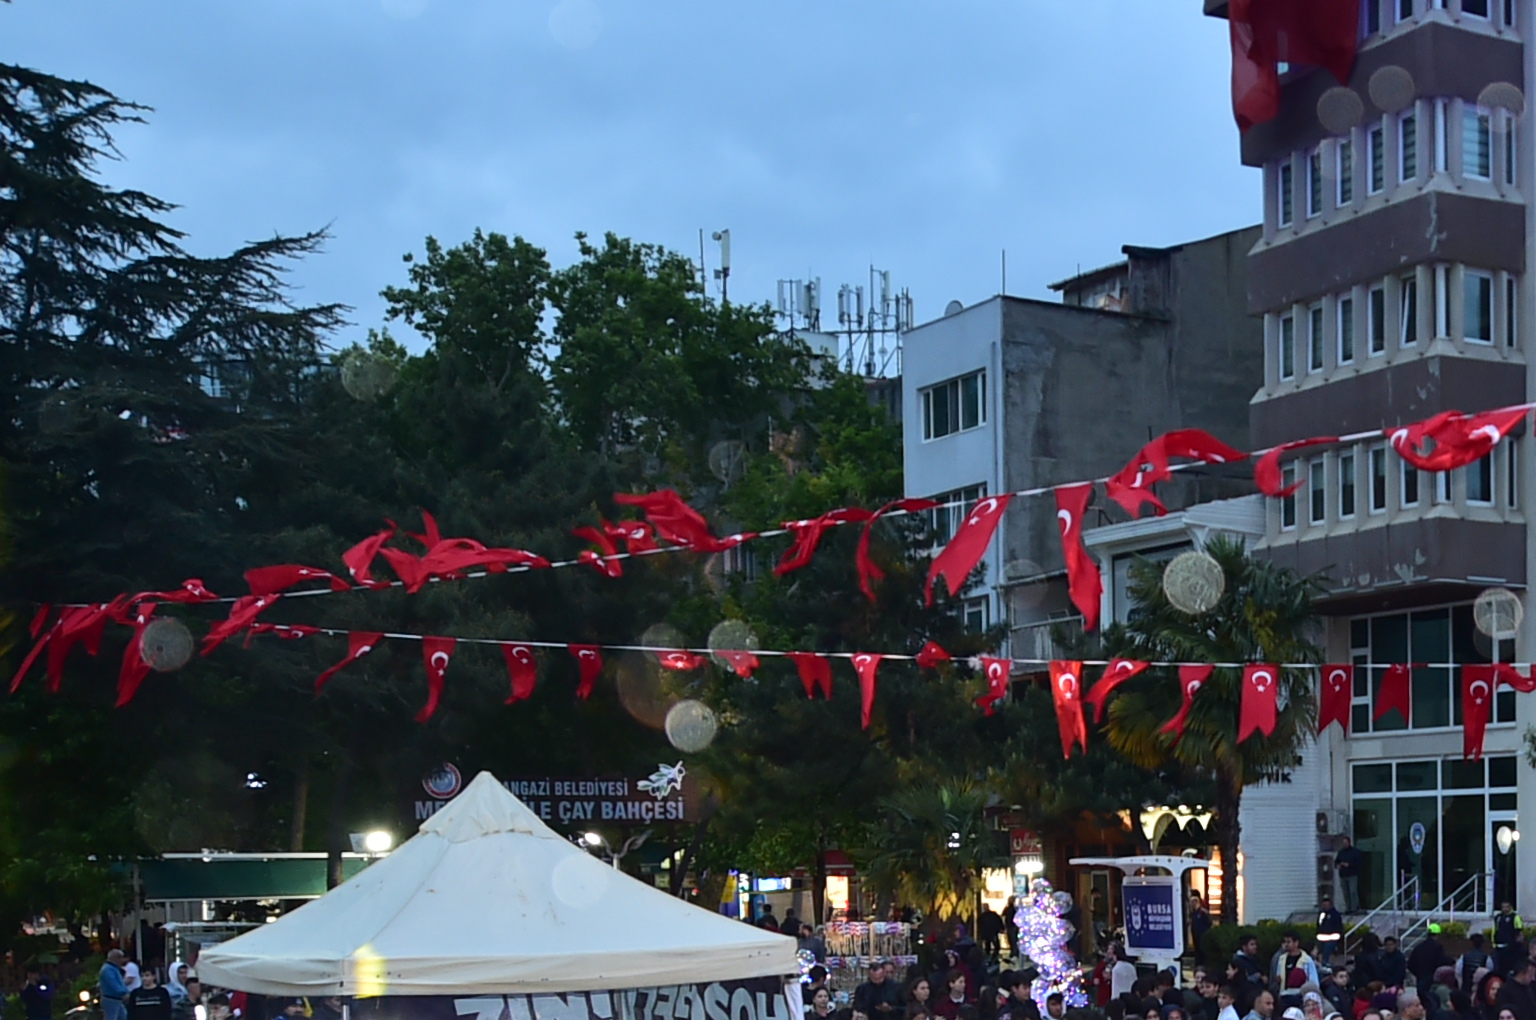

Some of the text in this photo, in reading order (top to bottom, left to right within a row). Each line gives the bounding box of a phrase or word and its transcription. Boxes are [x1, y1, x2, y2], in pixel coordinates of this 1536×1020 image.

[504, 777, 629, 796] ANGAZİ BELEDİYESİ
[558, 800, 595, 825] ÇAY
[600, 796, 685, 825] BAHÇESİ
[1146, 903, 1172, 915] BURSA
